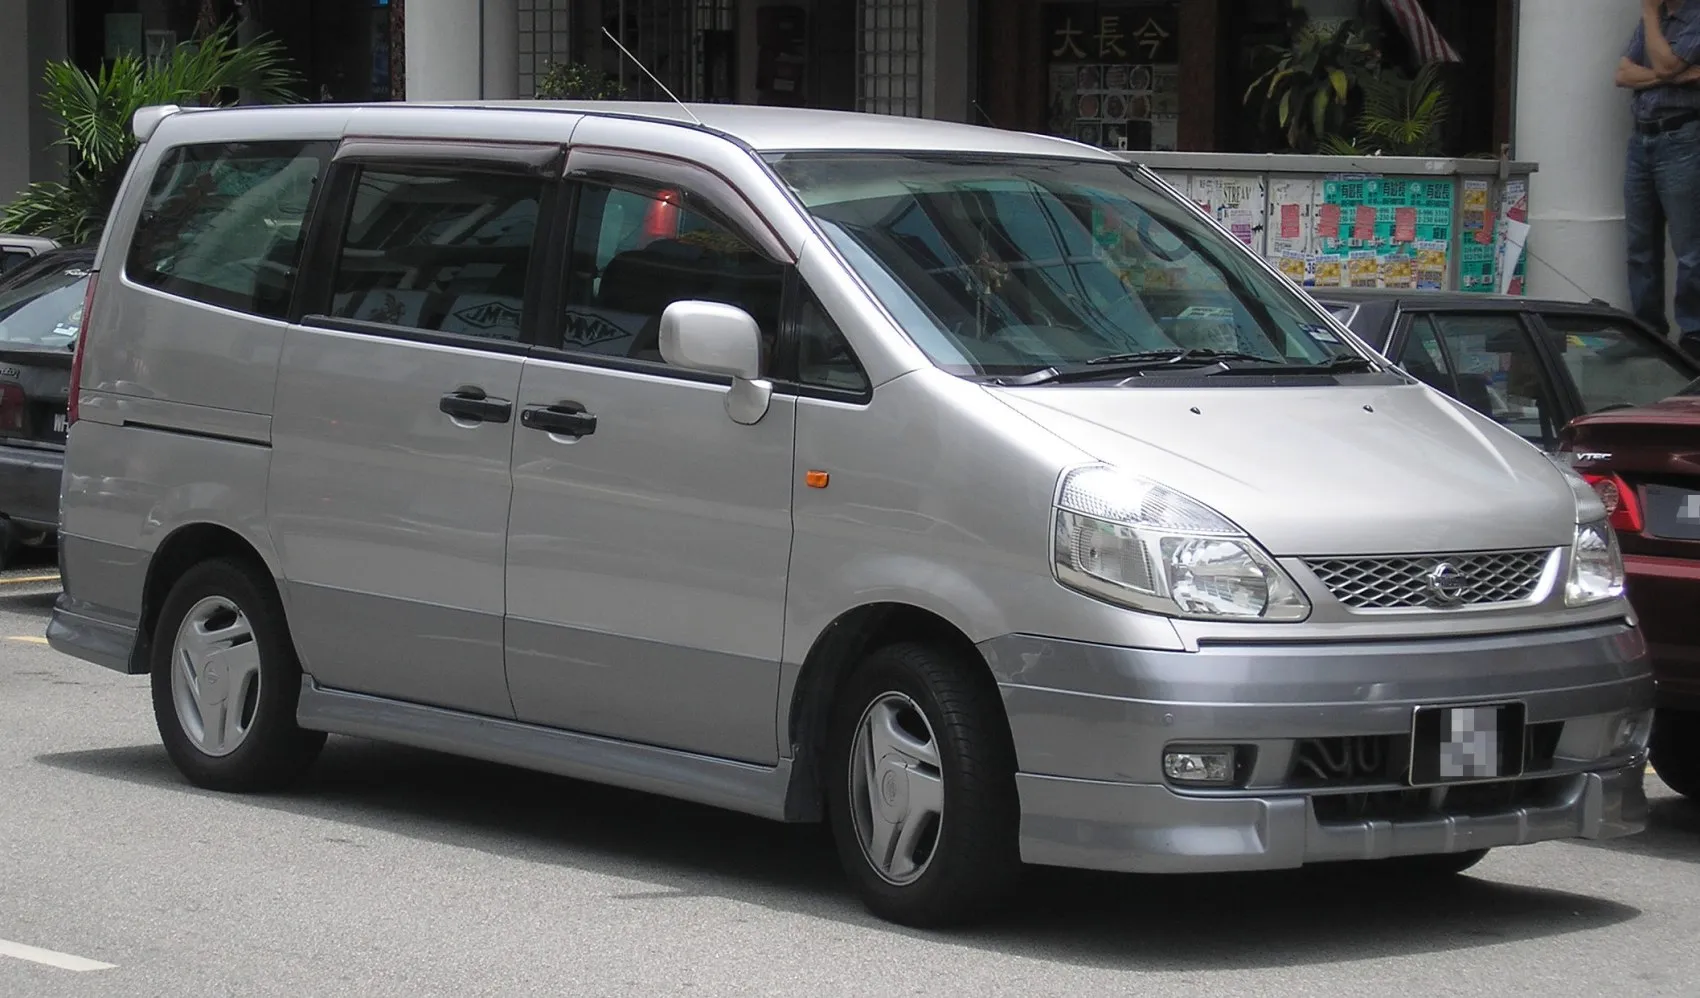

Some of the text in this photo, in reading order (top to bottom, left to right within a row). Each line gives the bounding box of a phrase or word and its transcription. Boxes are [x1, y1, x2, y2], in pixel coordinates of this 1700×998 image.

[1052, 16, 1169, 59] 大長今
[1577, 452, 1612, 460] VTEC
